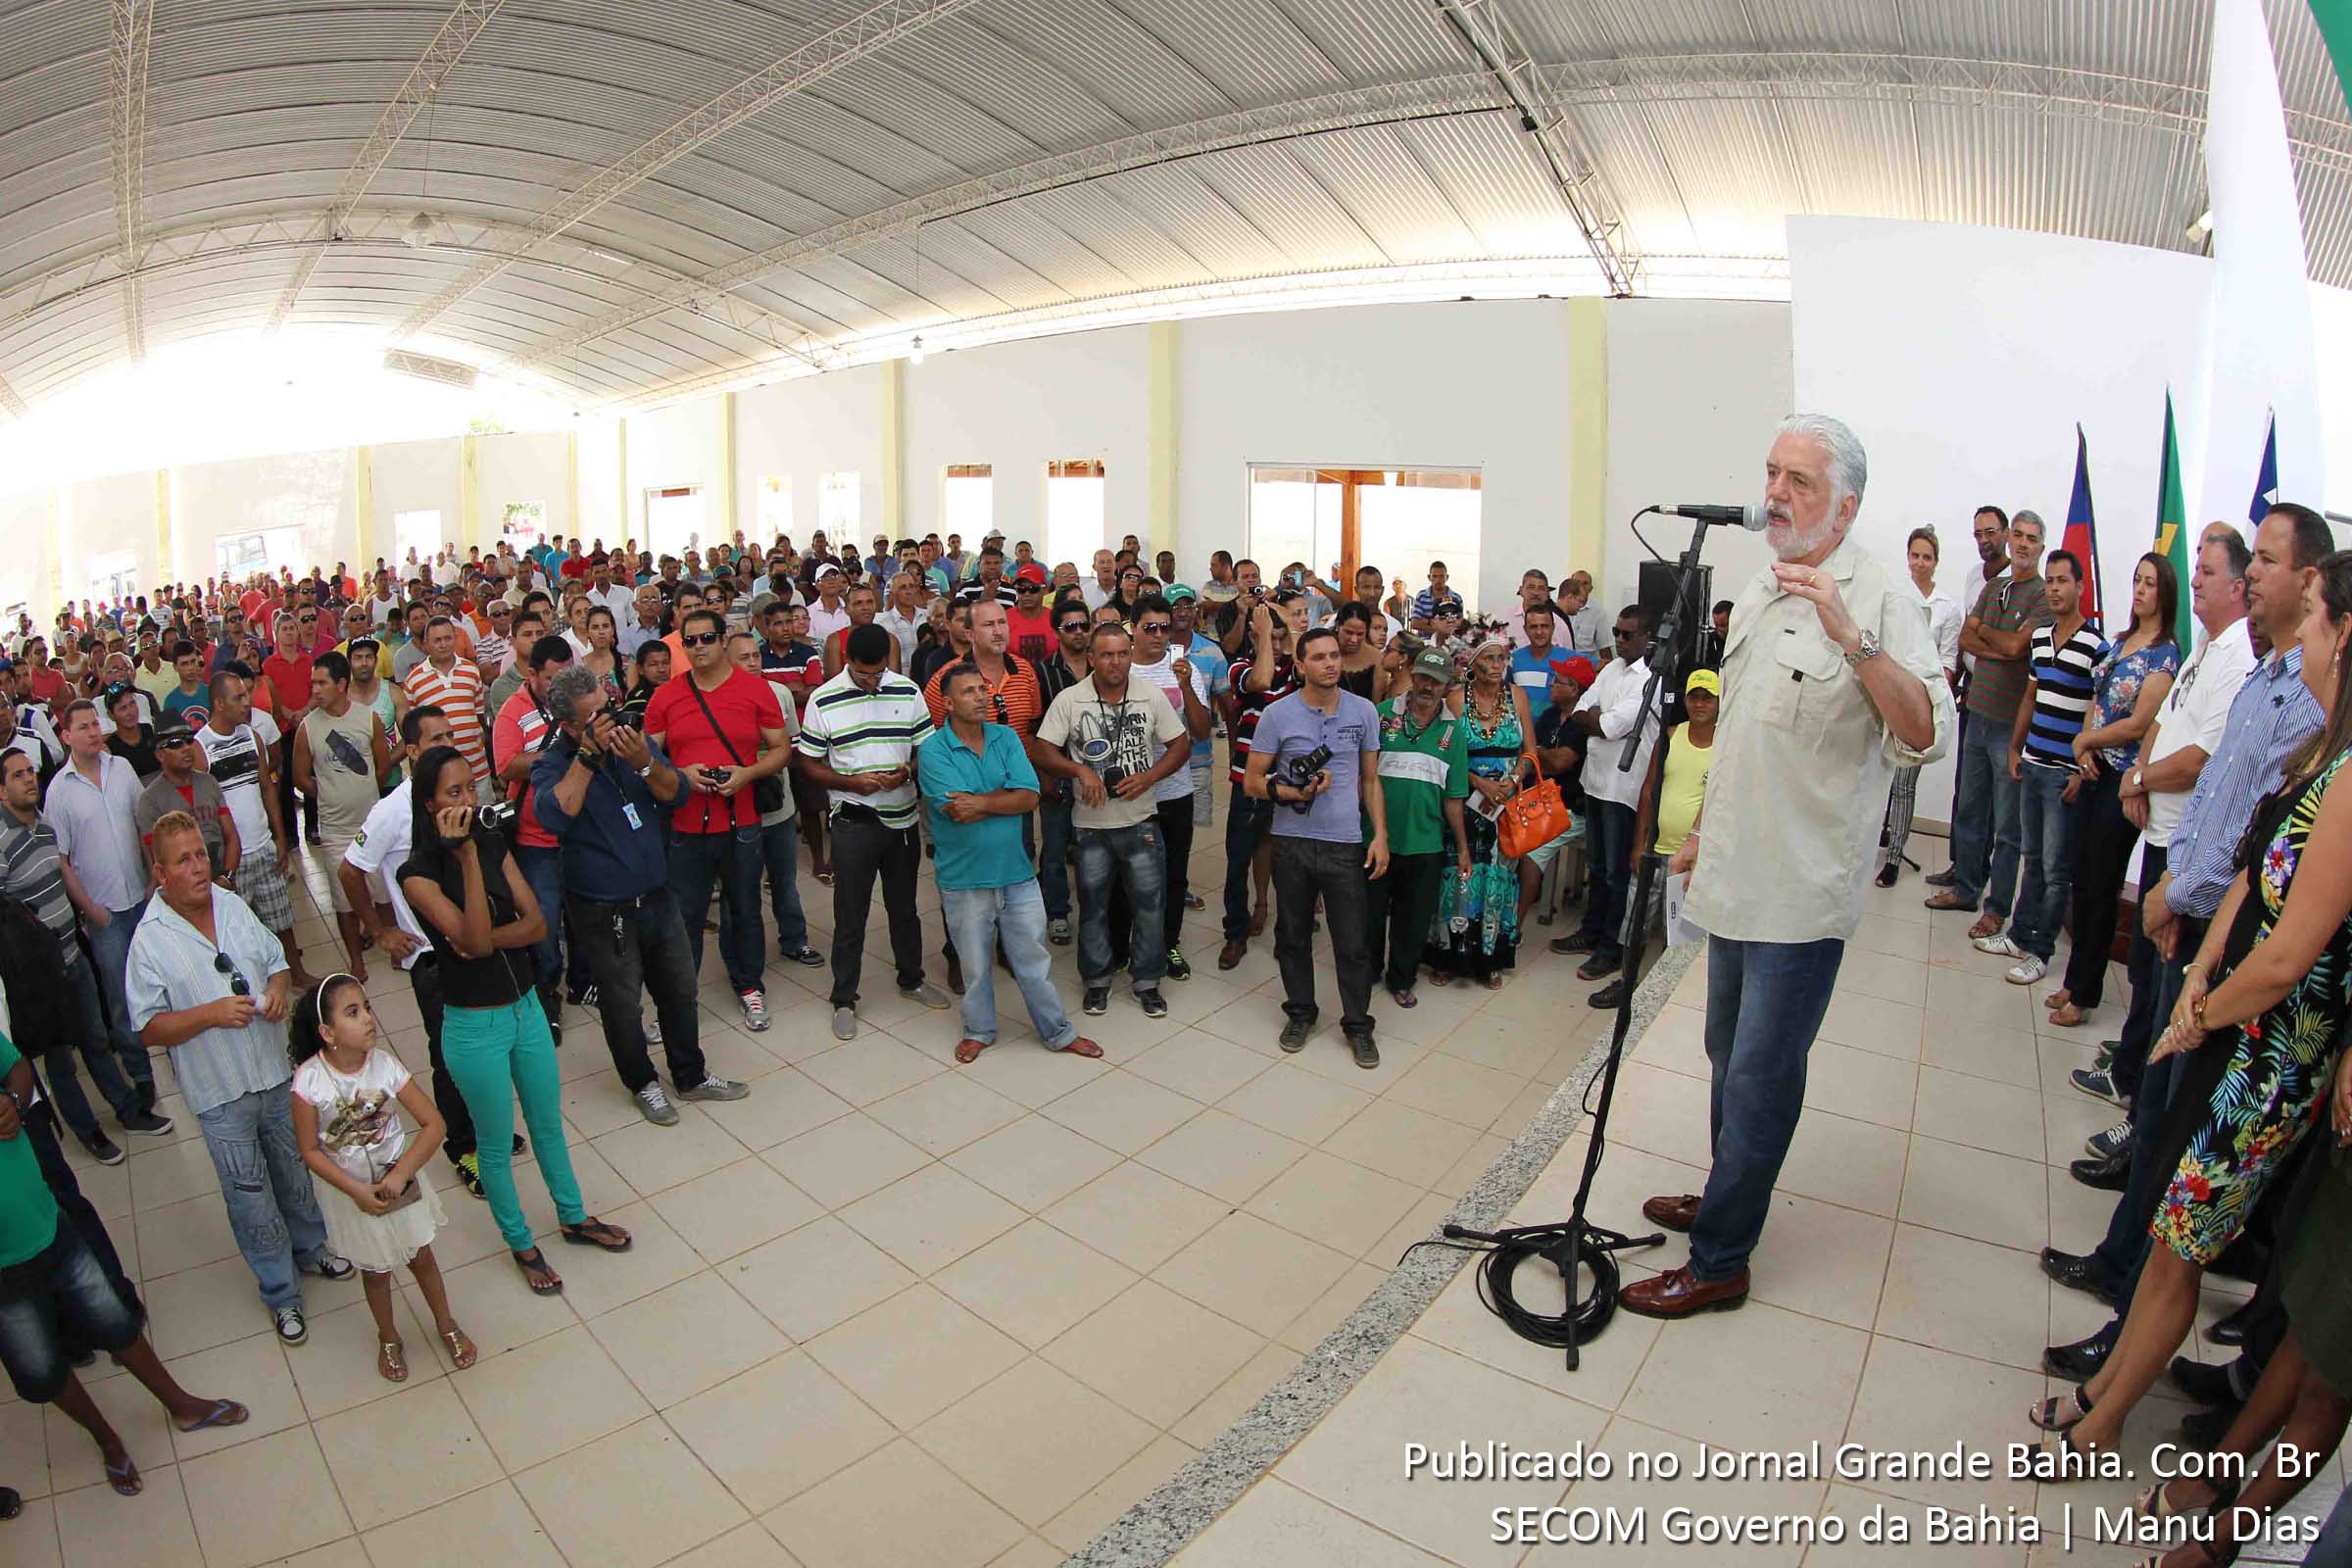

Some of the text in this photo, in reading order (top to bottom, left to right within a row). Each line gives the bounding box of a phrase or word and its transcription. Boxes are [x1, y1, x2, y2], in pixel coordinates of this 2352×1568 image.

[1124, 727, 1146, 738] FOR
[1124, 737, 1146, 749] ALL
[1122, 745, 1148, 762] THE
